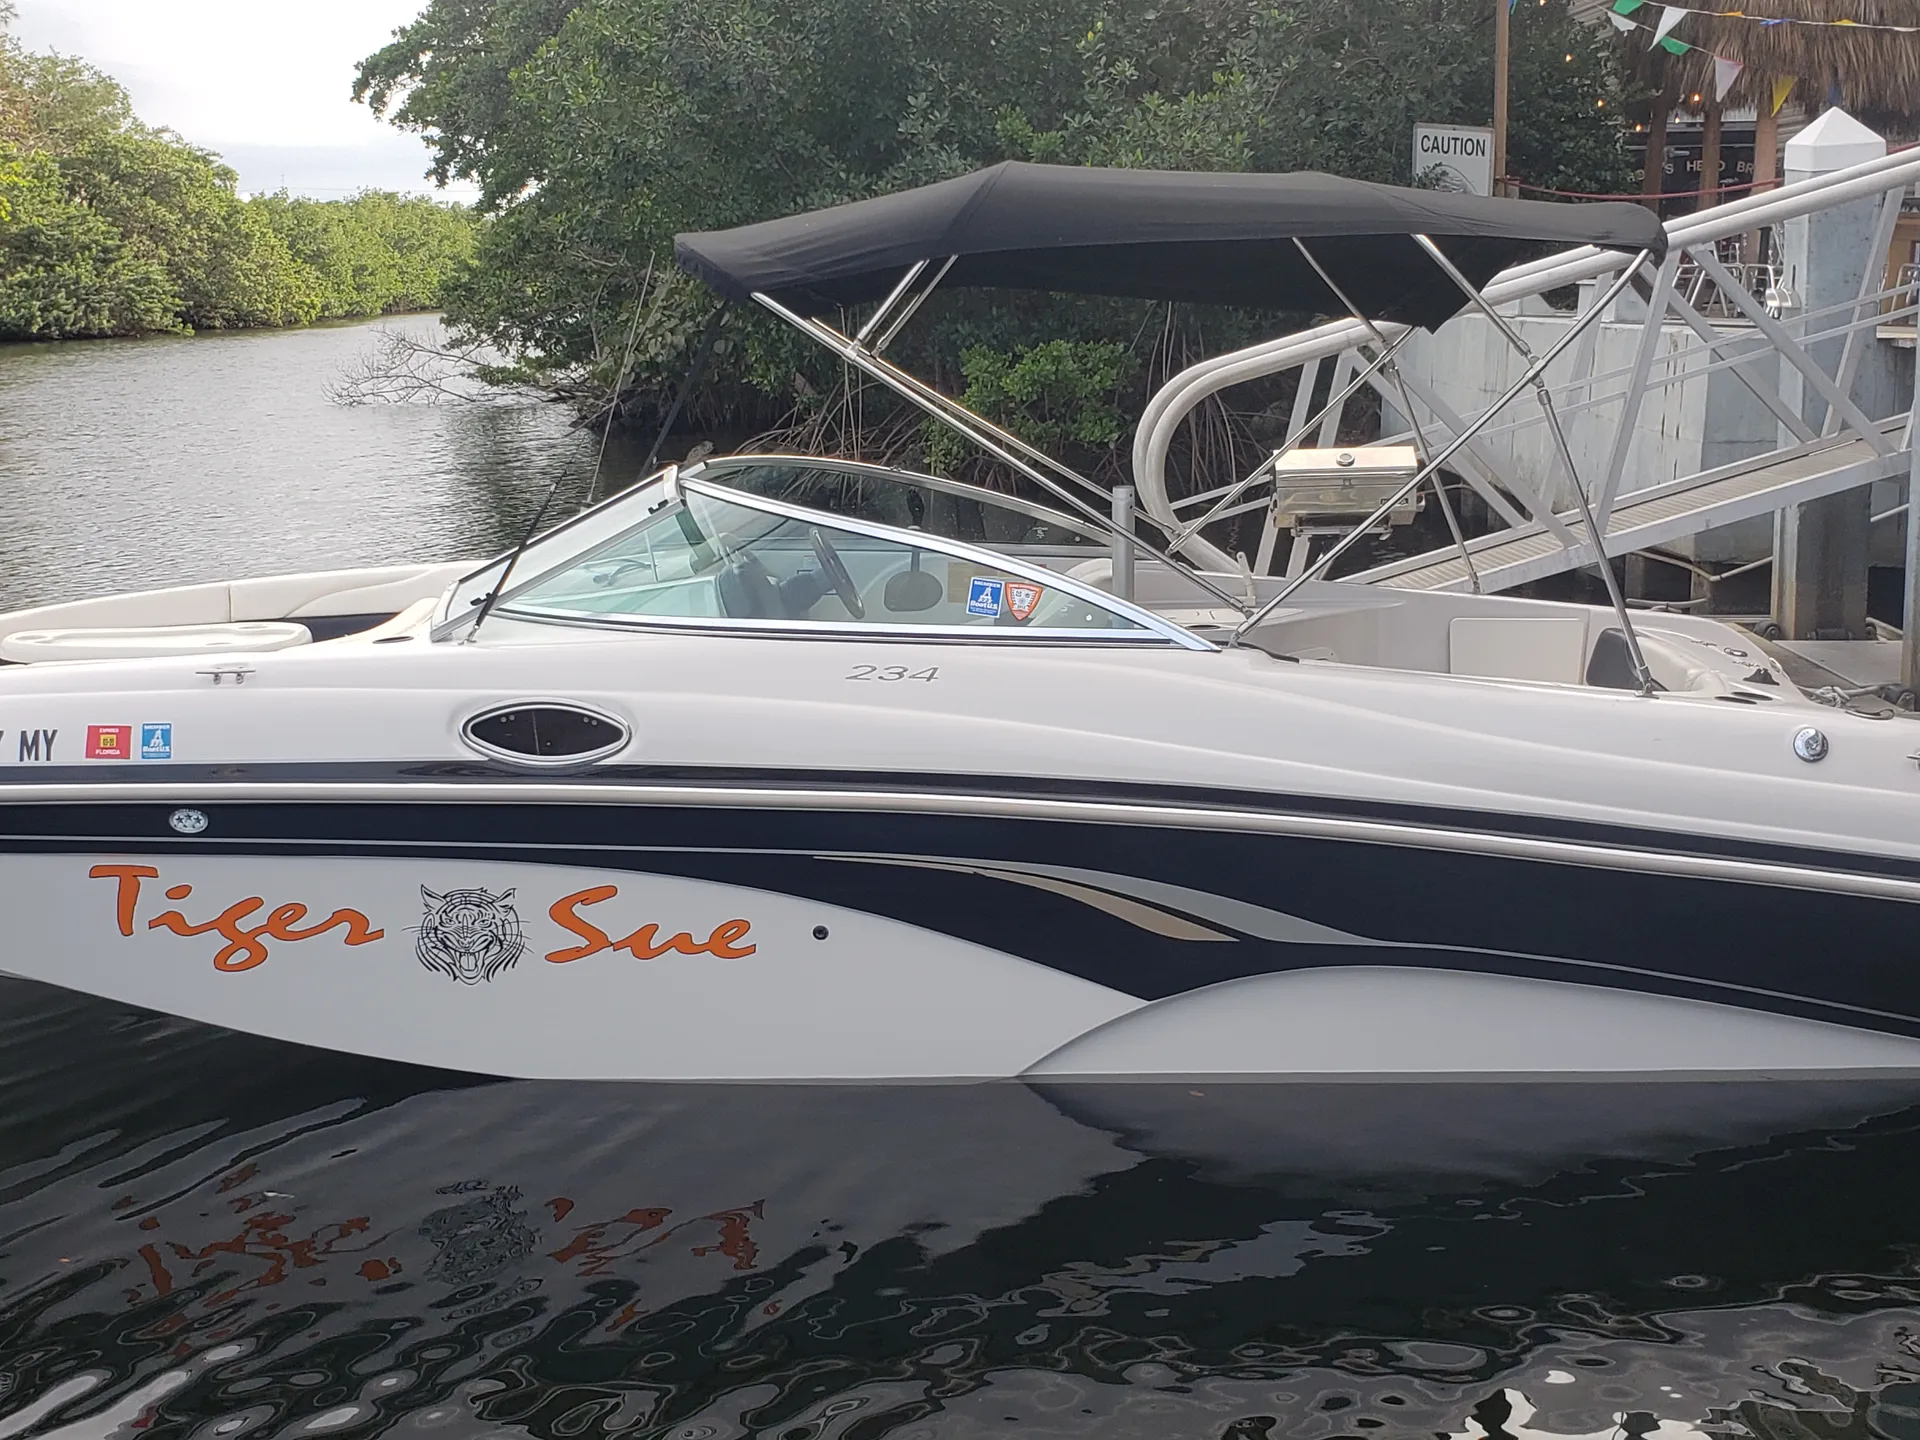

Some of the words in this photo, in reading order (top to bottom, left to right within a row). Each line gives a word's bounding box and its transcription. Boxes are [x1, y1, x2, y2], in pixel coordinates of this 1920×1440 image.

[1420, 134, 1486, 157] CAUTION
[1686, 160, 1726, 172] HED
[845, 664, 940, 683] 234
[19, 729, 58, 763] MY
[95, 748, 121, 756] FLORIDA
[88, 863, 385, 973] Tiger
[544, 884, 758, 963] Sue
